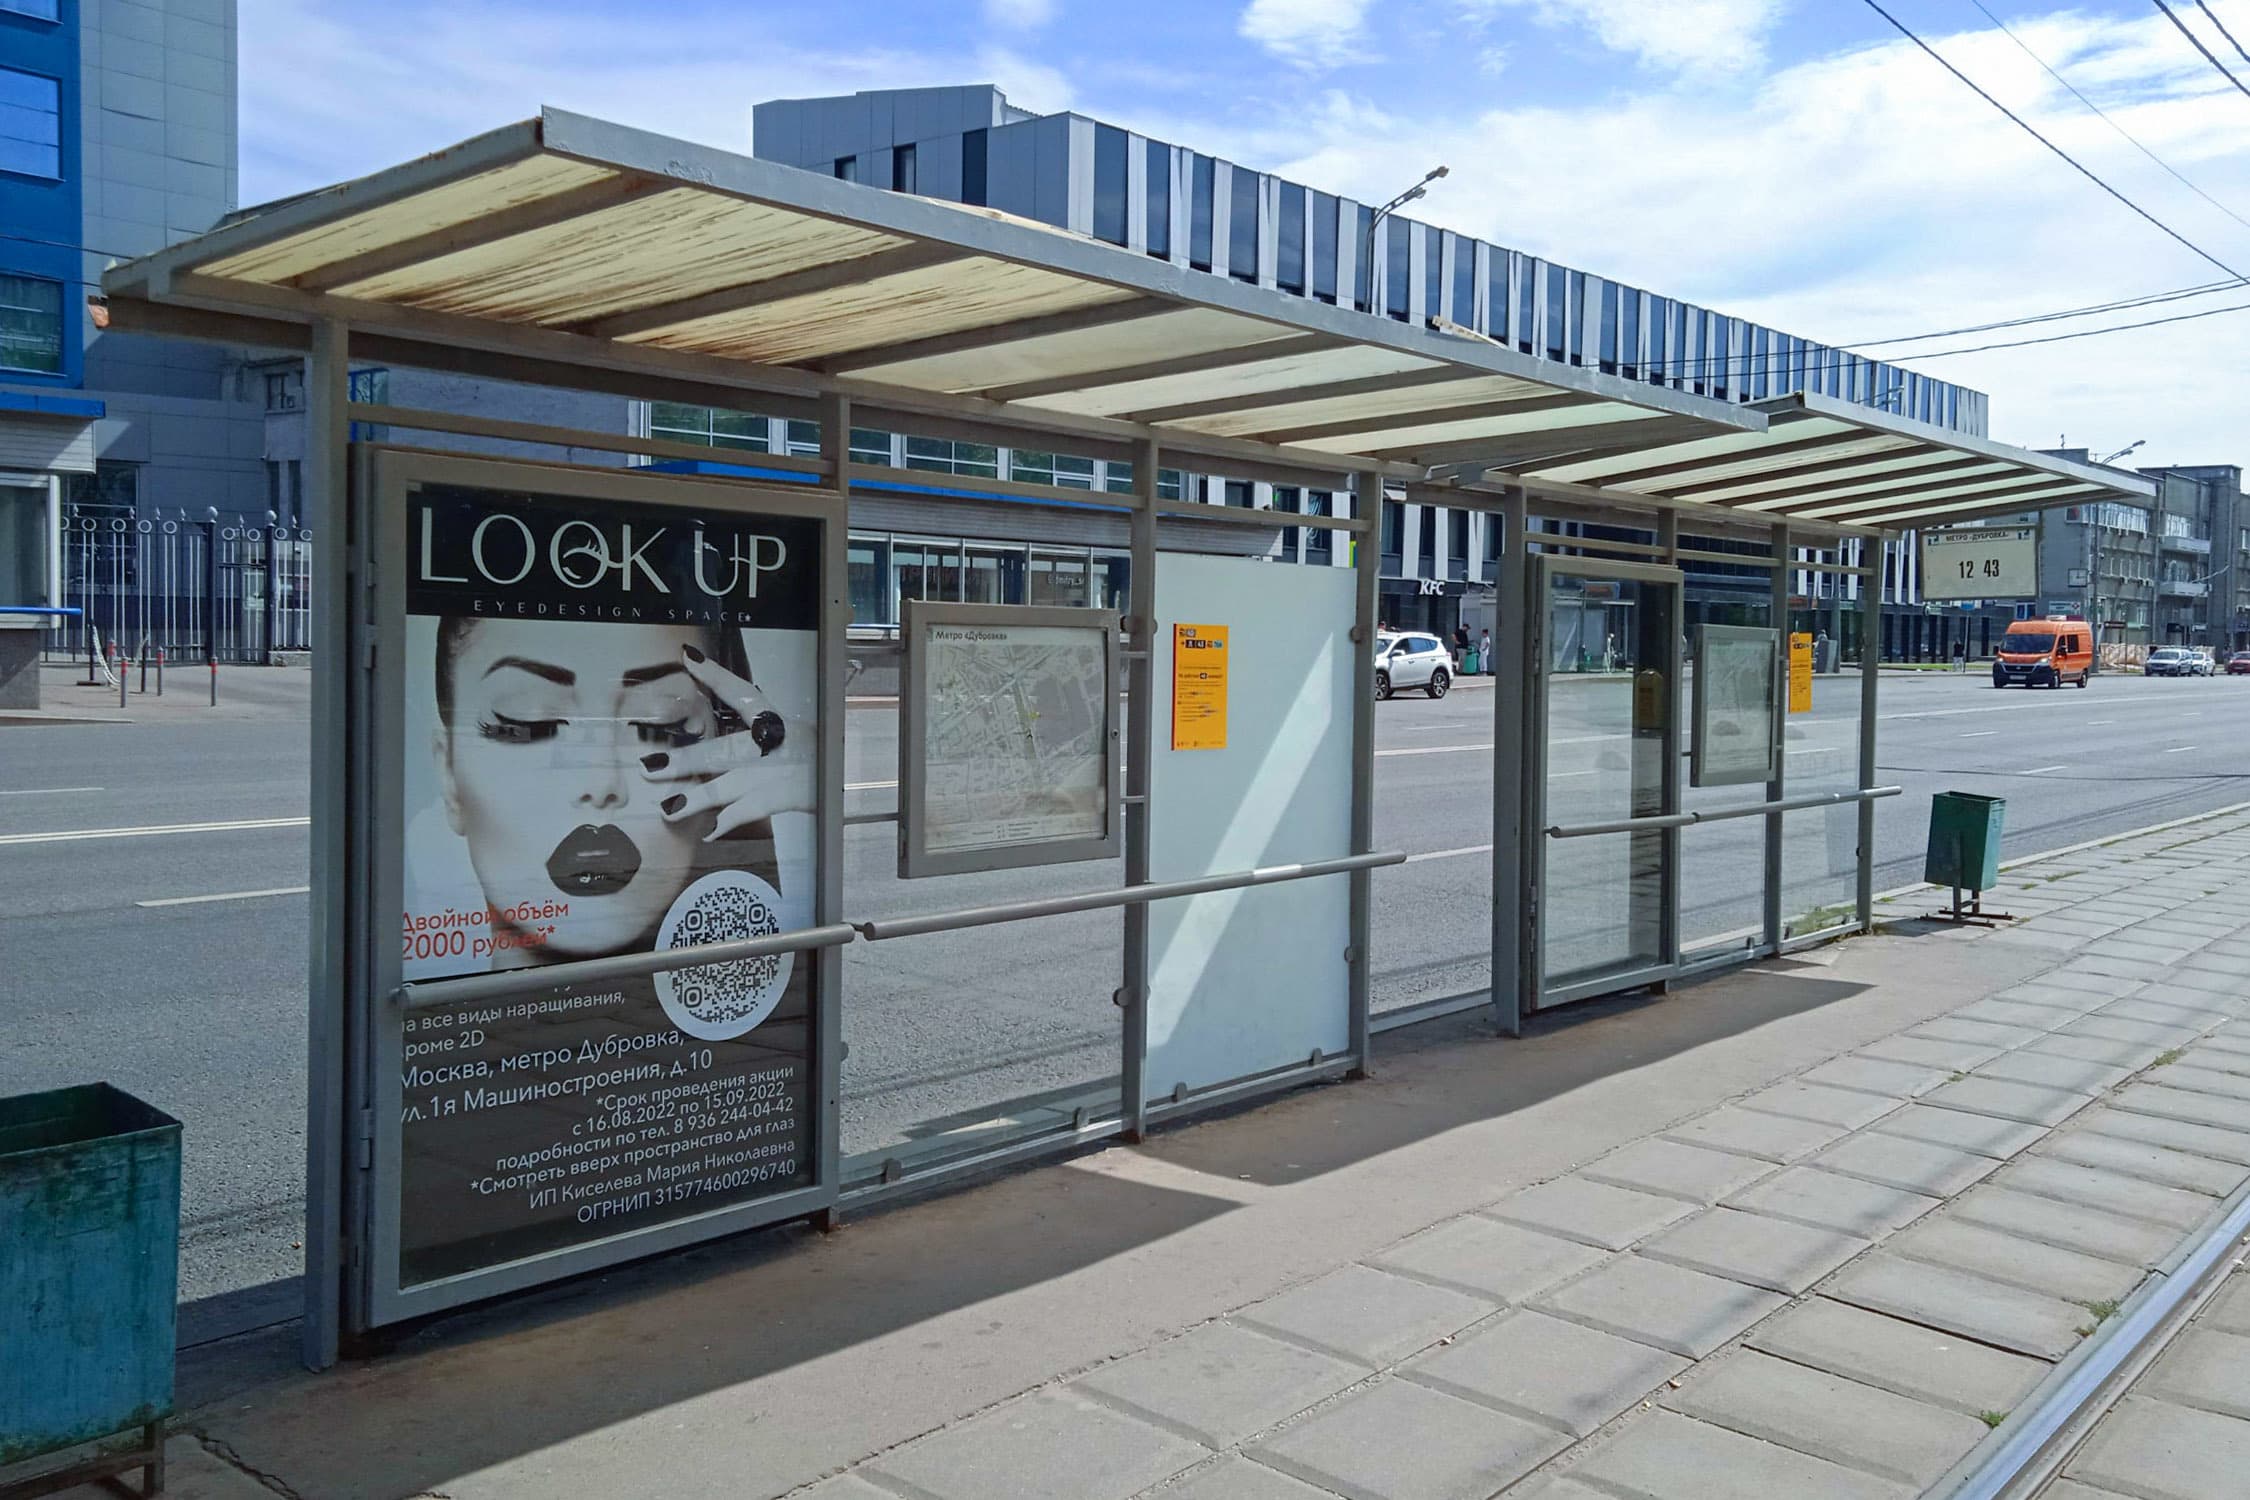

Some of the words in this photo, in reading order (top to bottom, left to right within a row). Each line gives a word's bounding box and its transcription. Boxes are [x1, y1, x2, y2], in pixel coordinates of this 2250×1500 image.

[420, 507, 671, 593] LOOK
[694, 530, 787, 598] UP
[1959, 561, 1974, 579] 12
[1984, 560, 2000, 577] 43
[1419, 580, 1445, 596] KFC
[474, 600, 641, 617] EYEDESIGN
[936, 631, 963, 640] Метро
[504, 900, 569, 921] объём
[402, 930, 465, 961] 2000
[422, 1014, 453, 1030] все
[458, 1008, 502, 1024] виды
[507, 991, 625, 1019] наращивания,
[402, 1061, 494, 1088] Москва,
[501, 1048, 572, 1072] метро
[577, 1030, 684, 1063] Дубровка,
[404, 1038, 454, 1061] роме
[459, 1029, 485, 1048] 2D
[464, 1064, 666, 1112] Машиностроения,
[652, 1076, 745, 1106] проведения
[749, 1066, 794, 1084] акции
[572, 1123, 582, 1136] с
[587, 1103, 675, 1133] 16.08.2022
[680, 1102, 699, 1115] по
[706, 1081, 785, 1109] 15.09.2022
[496, 1137, 611, 1171] подробности
[616, 1132, 636, 1146] по
[640, 1126, 670, 1141] тел.
[674, 1118, 683, 1134] 8
[688, 1112, 716, 1131] 936
[721, 1097, 793, 1125] 244-04-42
[570, 1154, 620, 1174] вверх
[624, 1131, 733, 1165] пространство
[736, 1124, 762, 1142] для
[766, 1118, 795, 1134] глаз
[530, 1188, 556, 1209] ИП
[562, 1174, 642, 1202] Киселева
[647, 1161, 700, 1182] Мария
[705, 1140, 795, 1170] Николаевна
[577, 1191, 650, 1223] ОГРНИП
[655, 1159, 795, 1205] 315774600296740
